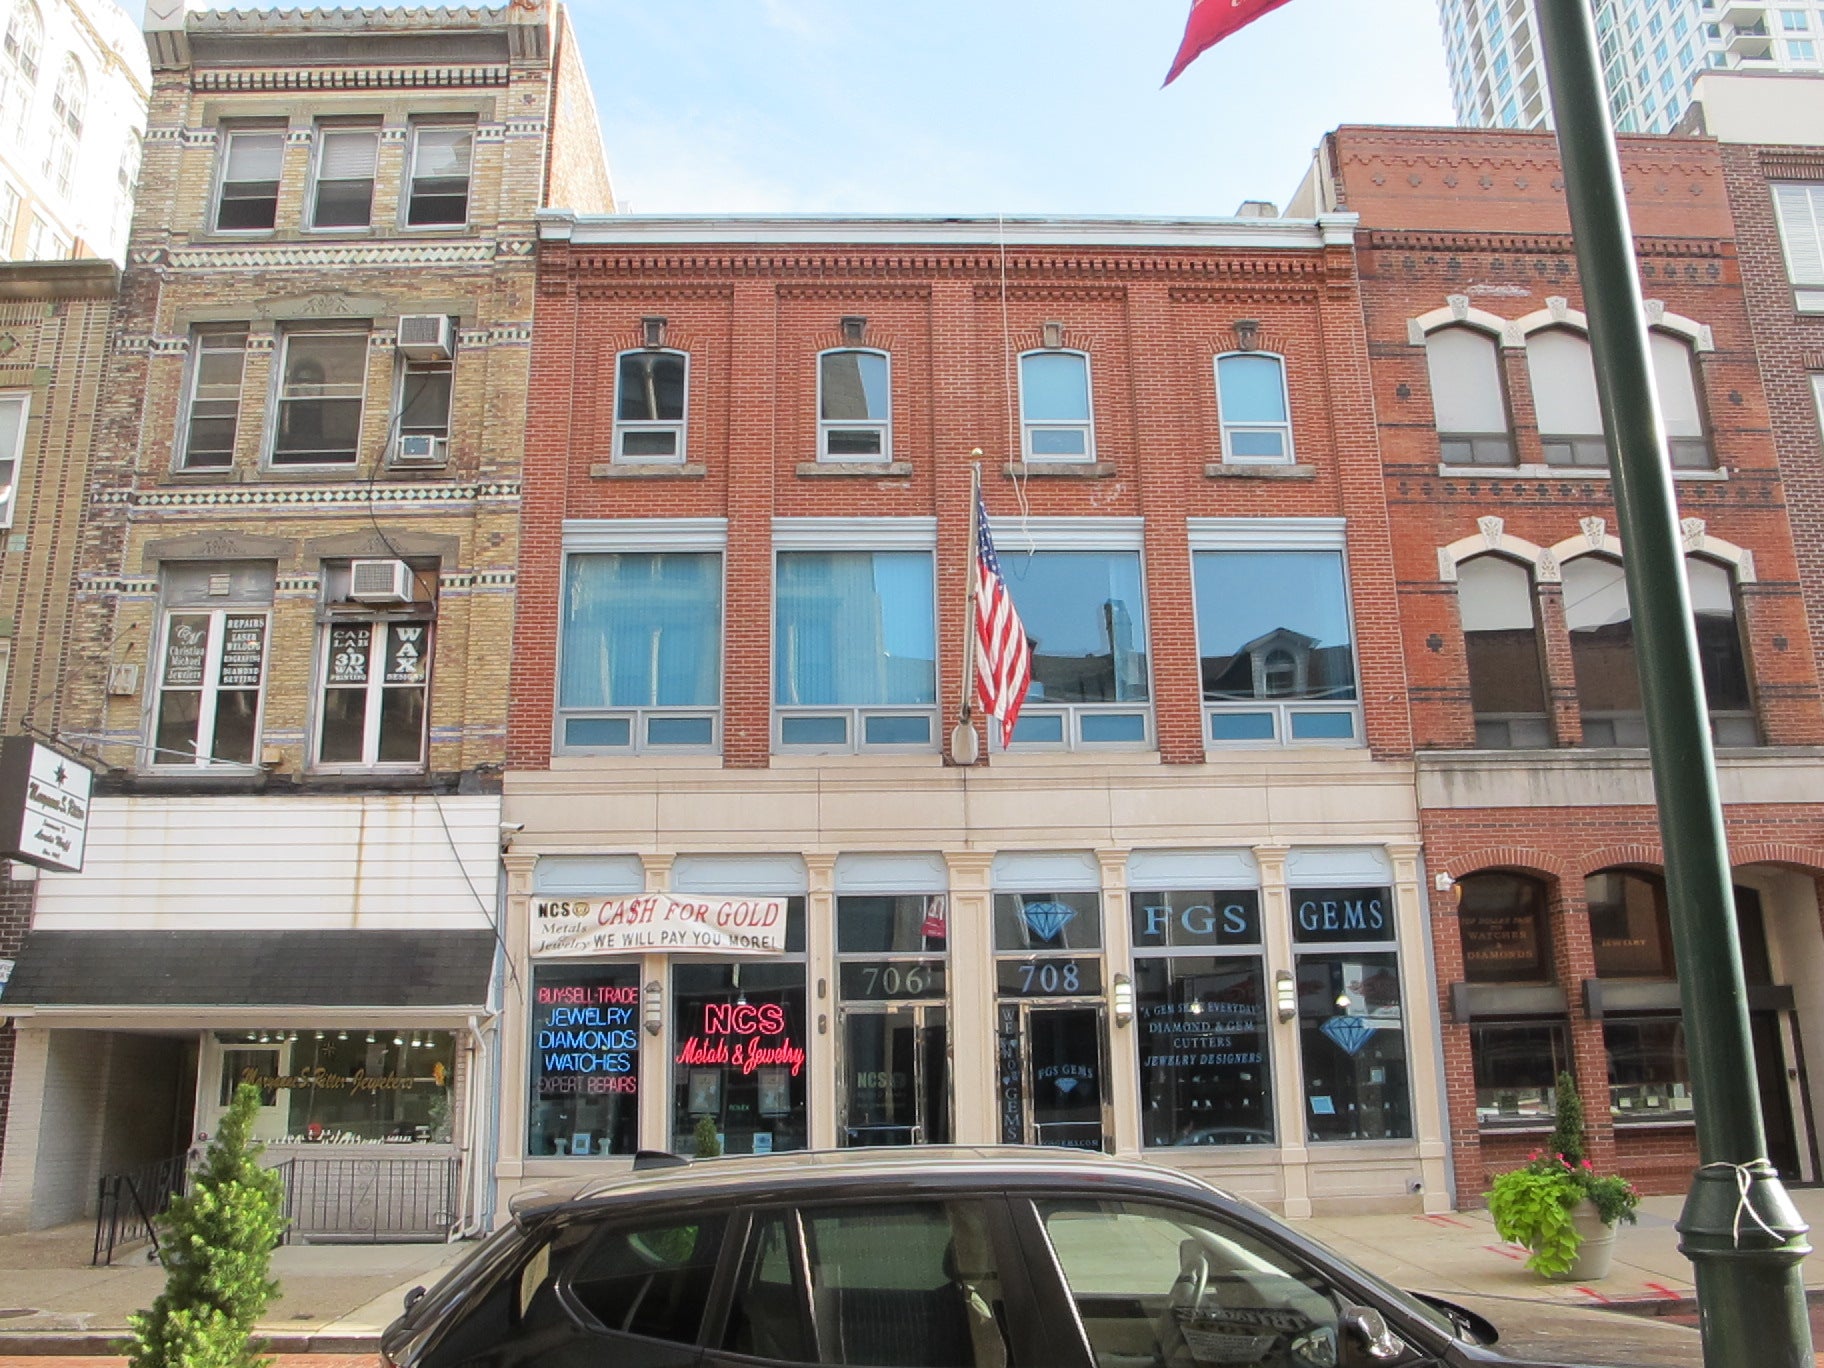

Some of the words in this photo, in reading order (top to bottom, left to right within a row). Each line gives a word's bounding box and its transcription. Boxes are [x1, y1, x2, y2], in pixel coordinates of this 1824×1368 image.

[226, 619, 264, 629] REPAIRS
[334, 630, 369, 639] CAD
[334, 639, 369, 647] LAB
[171, 655, 201, 666] Michael
[335, 653, 365, 666] 3D
[334, 665, 364, 674] WAX
[538, 903, 570, 918] NCS
[663, 902, 709, 922] FOR
[716, 901, 780, 928] GOLD
[1143, 904, 1248, 936] FGS
[1299, 899, 1384, 932] GEMS
[541, 922, 588, 935] Metals
[537, 938, 590, 953] Jewelry
[593, 934, 615, 948] WE
[621, 931, 653, 947] WILL
[660, 929, 687, 946] PAY
[692, 929, 722, 947] YOU
[728, 932, 777, 950] MORE!
[862, 967, 925, 995] 706
[1018, 963, 1081, 994] 708
[545, 1007, 633, 1027] JEWELRY
[705, 1003, 784, 1035] NCS
[1149, 1021, 1211, 1033] DIAMOND
[538, 1029, 638, 1050] DIAMONDS
[1173, 1036, 1233, 1048] CUTTERS
[544, 1052, 631, 1073] WATCHES
[675, 1036, 729, 1065] Metals
[731, 1043, 744, 1065] &
[742, 1035, 805, 1077] Jewelry
[1143, 1054, 1196, 1067] JEWELRY
[1200, 1052, 1262, 1065] DESIGNERS
[313, 1067, 345, 1089] Ritter
[350, 1068, 414, 1095] Jewelers
[857, 1071, 888, 1089] NCS
[1038, 1065, 1058, 1080] FGS
[1061, 1063, 1093, 1079] GEMS
[537, 1076, 584, 1093] EXPERT
[586, 1076, 637, 1094] REPAIRS
[1004, 1087, 1020, 1140] GEMS
